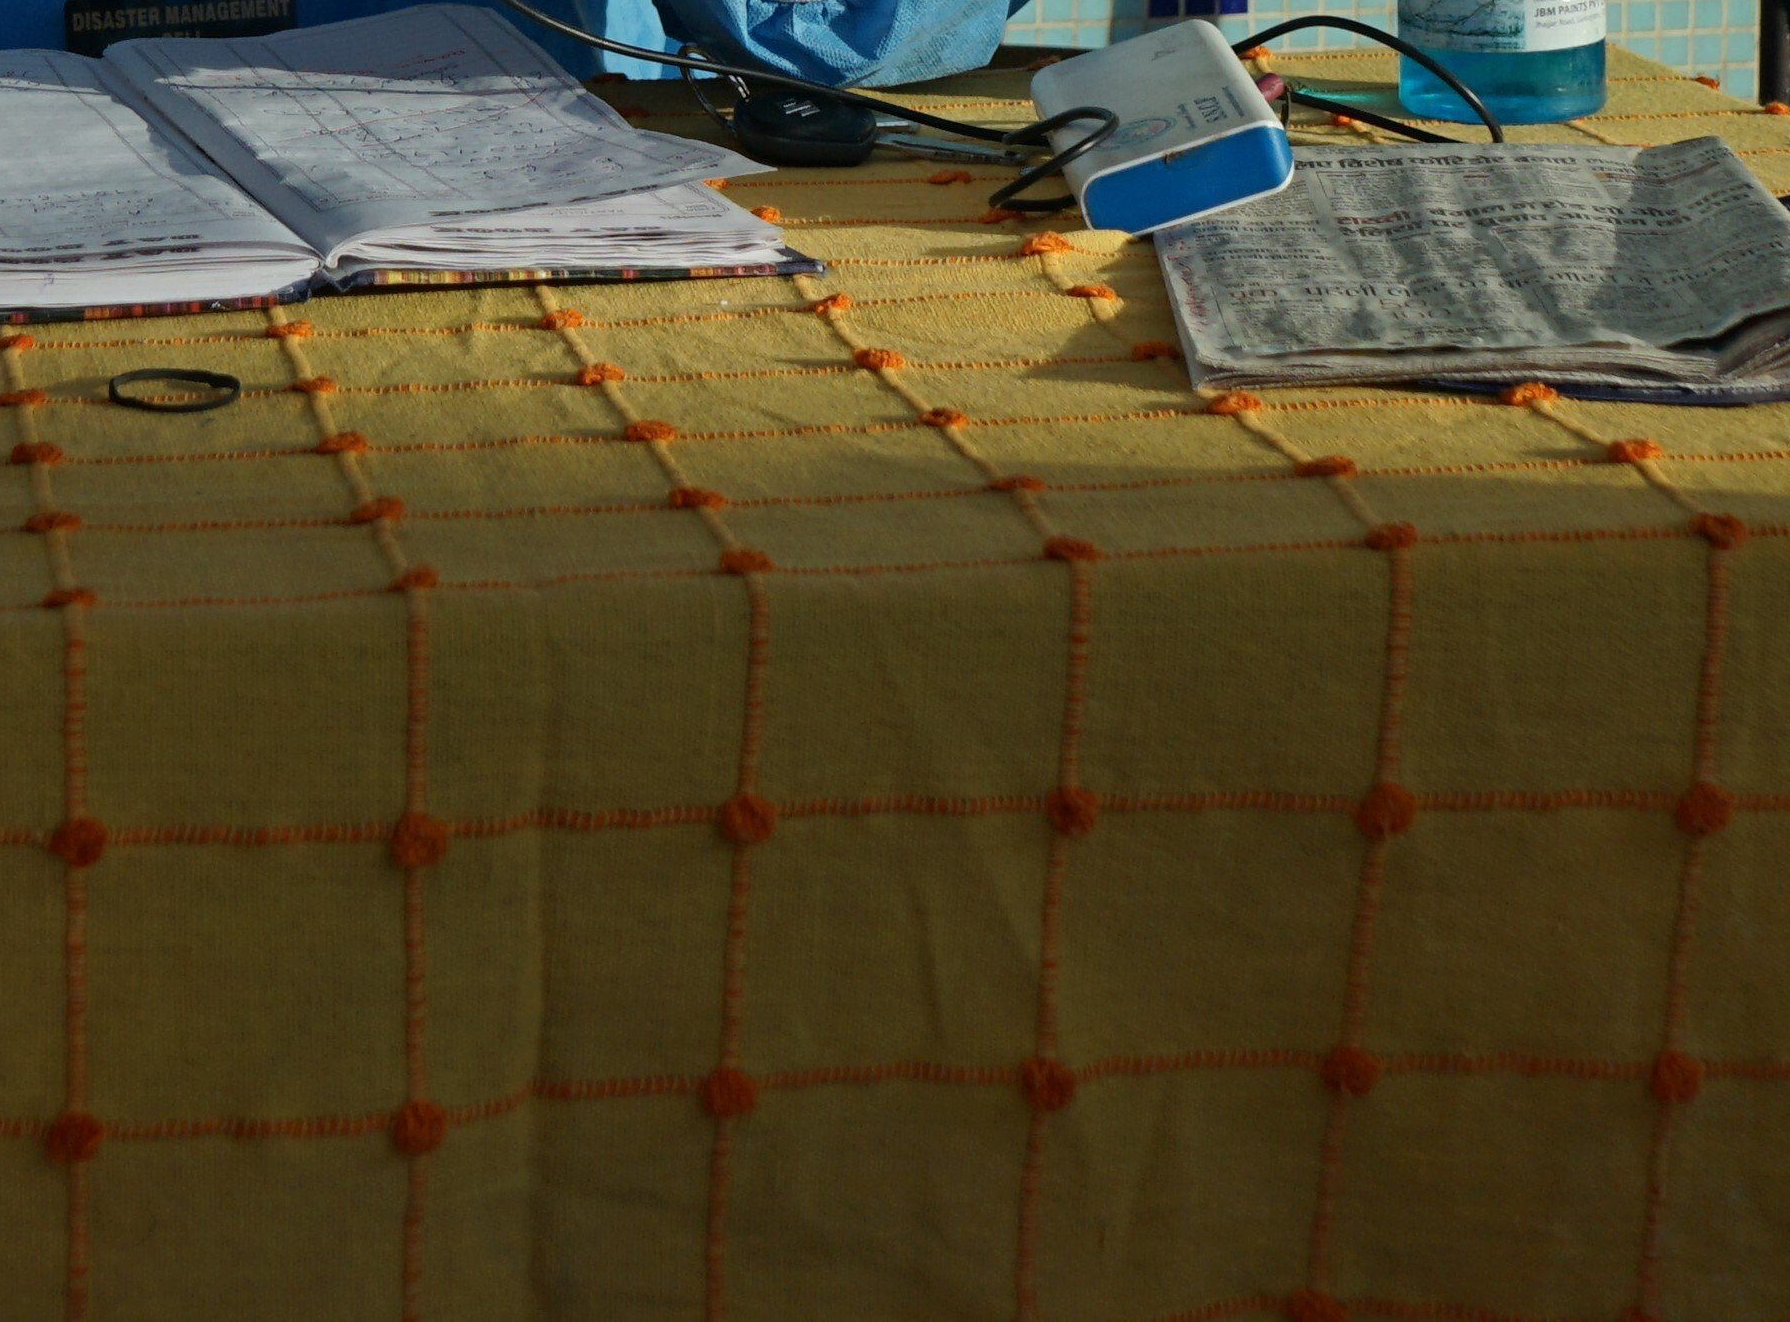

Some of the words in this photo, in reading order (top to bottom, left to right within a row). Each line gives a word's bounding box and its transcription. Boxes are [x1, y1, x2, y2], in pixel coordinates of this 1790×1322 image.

[71, 5, 163, 33] DISASTER
[1534, 5, 1557, 19] JBM
[101, 233, 201, 247] DAY
